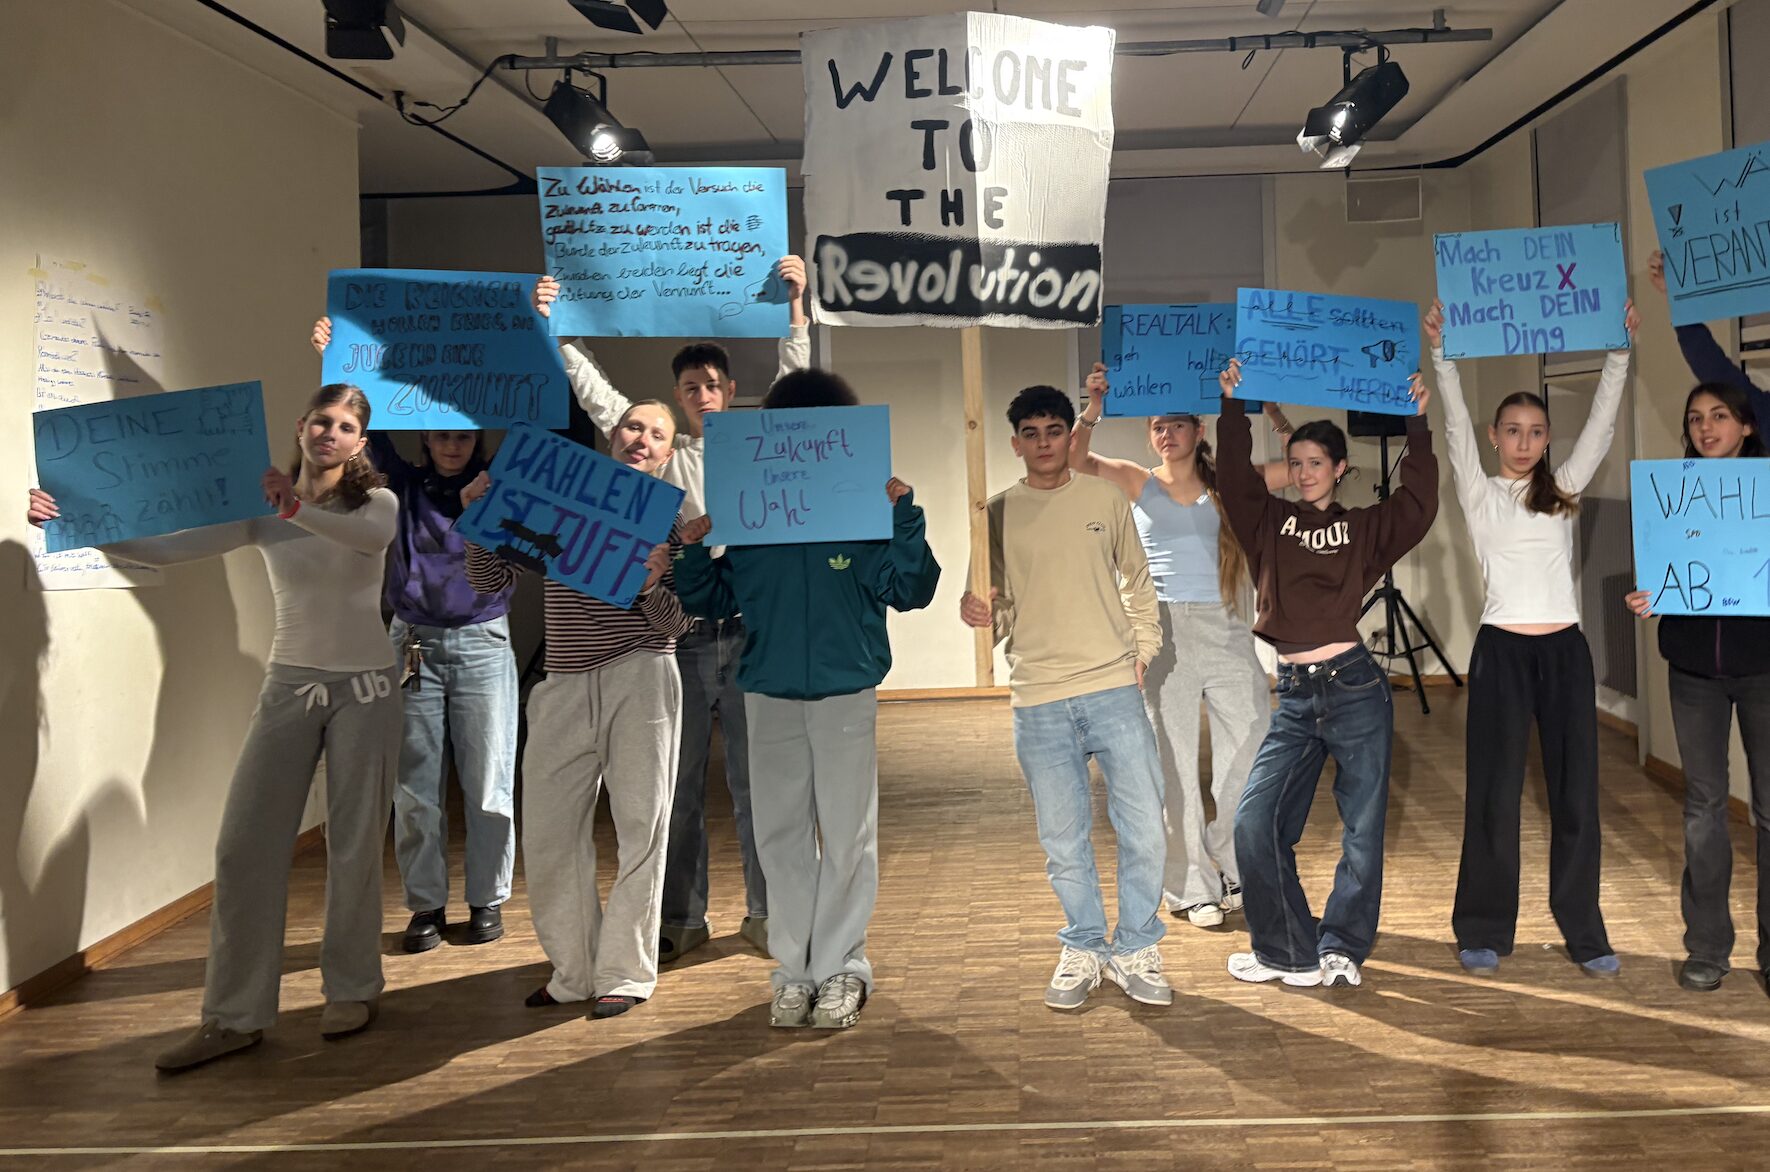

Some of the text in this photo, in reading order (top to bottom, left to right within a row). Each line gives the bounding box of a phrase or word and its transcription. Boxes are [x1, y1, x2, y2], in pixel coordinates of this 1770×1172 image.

[828, 46, 1087, 118] WELCOME
[911, 119, 993, 173] TO
[541, 177, 571, 197] Zu
[576, 176, 641, 195] Wählen
[644, 180, 661, 194] ist
[743, 181, 765, 192] die
[886, 187, 1008, 229] THE
[1715, 200, 1740, 224] ist
[610, 225, 635, 235] zu
[636, 221, 691, 236] werden
[697, 217, 712, 235] ist
[718, 220, 740, 234] die
[685, 241, 706, 251] zu
[708, 238, 765, 260] tragen,
[1439, 231, 1576, 267] Mach DEIN
[714, 262, 744, 278] die
[816, 243, 1100, 312] Revolution
[1471, 267, 1549, 297] Kreuz
[617, 287, 647, 300] der
[1246, 290, 1325, 324] ALLE
[1450, 288, 1600, 327] Mach DEIN
[1120, 313, 1233, 336] REALTALK:
[1502, 322, 1565, 354] Ding
[1113, 350, 1140, 372] geh
[386, 373, 550, 421] ZUKUNFT
[1113, 376, 1172, 399] wählen
[38, 407, 183, 461] DEINE
[745, 428, 853, 463] Zukunft
[93, 447, 231, 491] Stimme
[505, 431, 656, 525] WÄHLEN
[739, 488, 811, 530] Wahl
[1650, 472, 1770, 520] WAHL
[1652, 560, 1713, 611] AB
